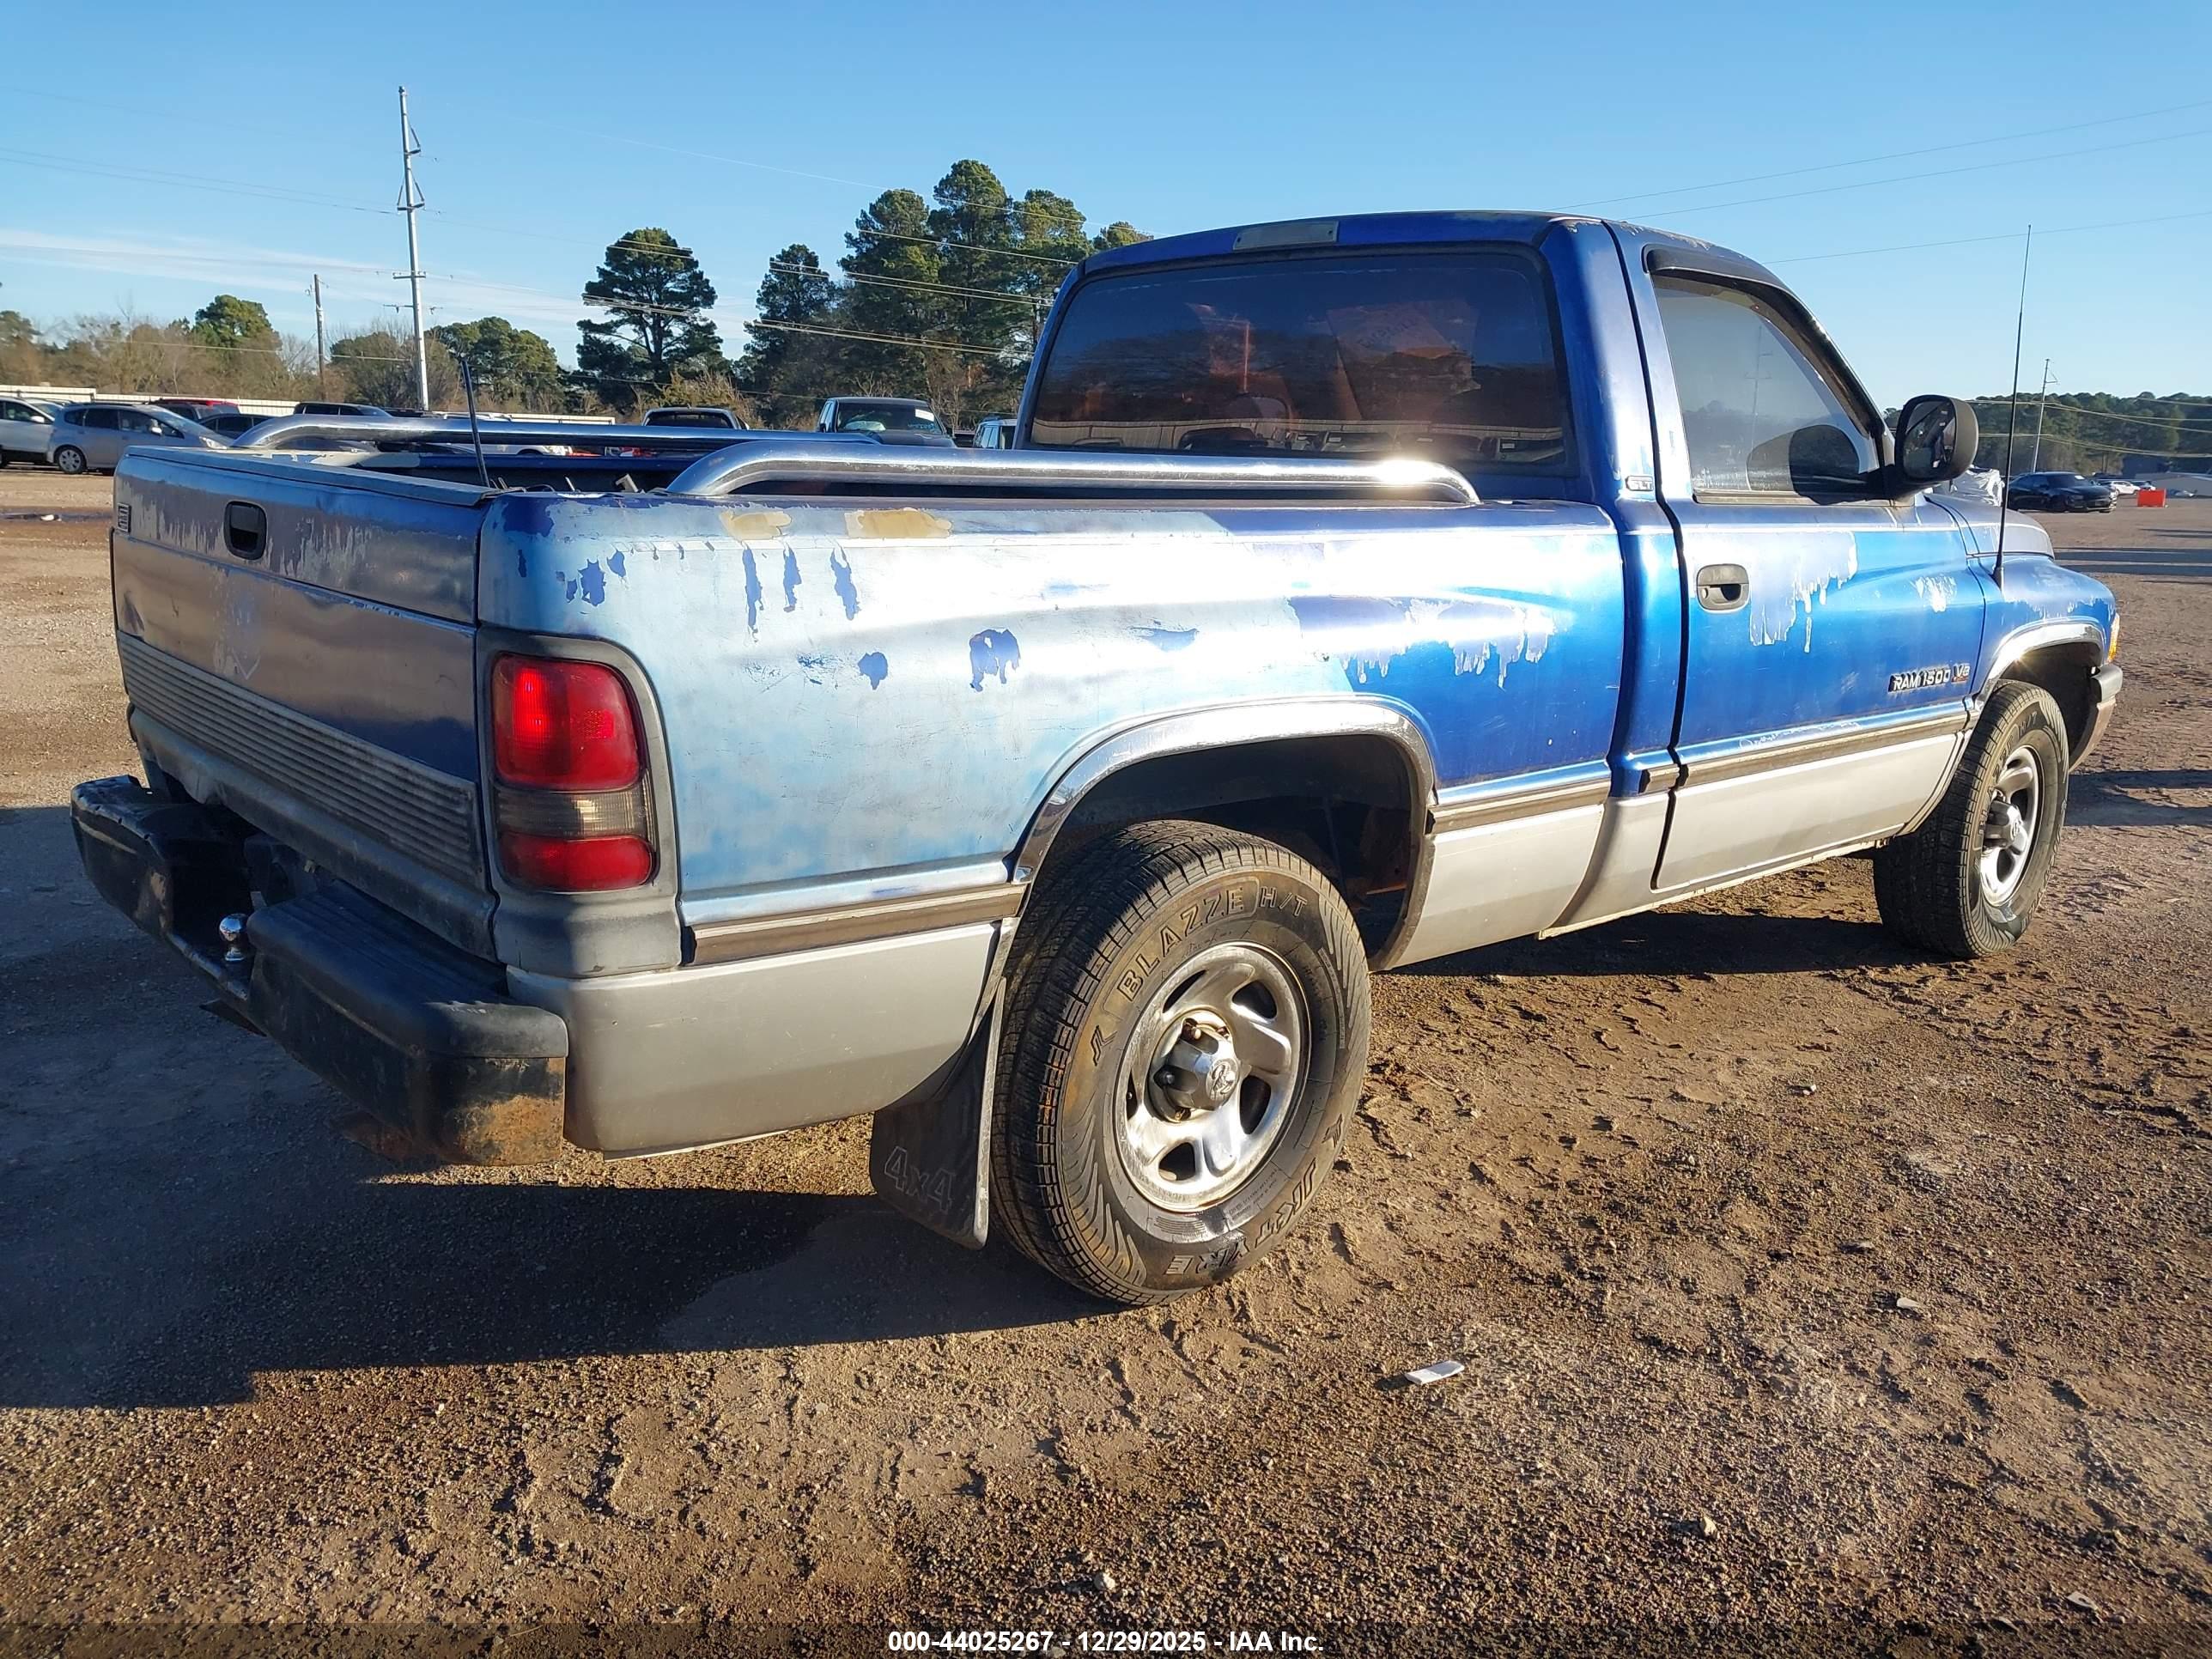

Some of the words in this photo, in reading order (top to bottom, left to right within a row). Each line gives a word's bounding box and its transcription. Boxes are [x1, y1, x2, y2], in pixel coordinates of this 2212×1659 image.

[1892, 672, 1922, 692] RAM
[1923, 668, 1951, 687] 1500
[1955, 664, 1971, 678] V8
[1115, 884, 1245, 1003] BLAZZE
[1258, 885, 1309, 919] H/T
